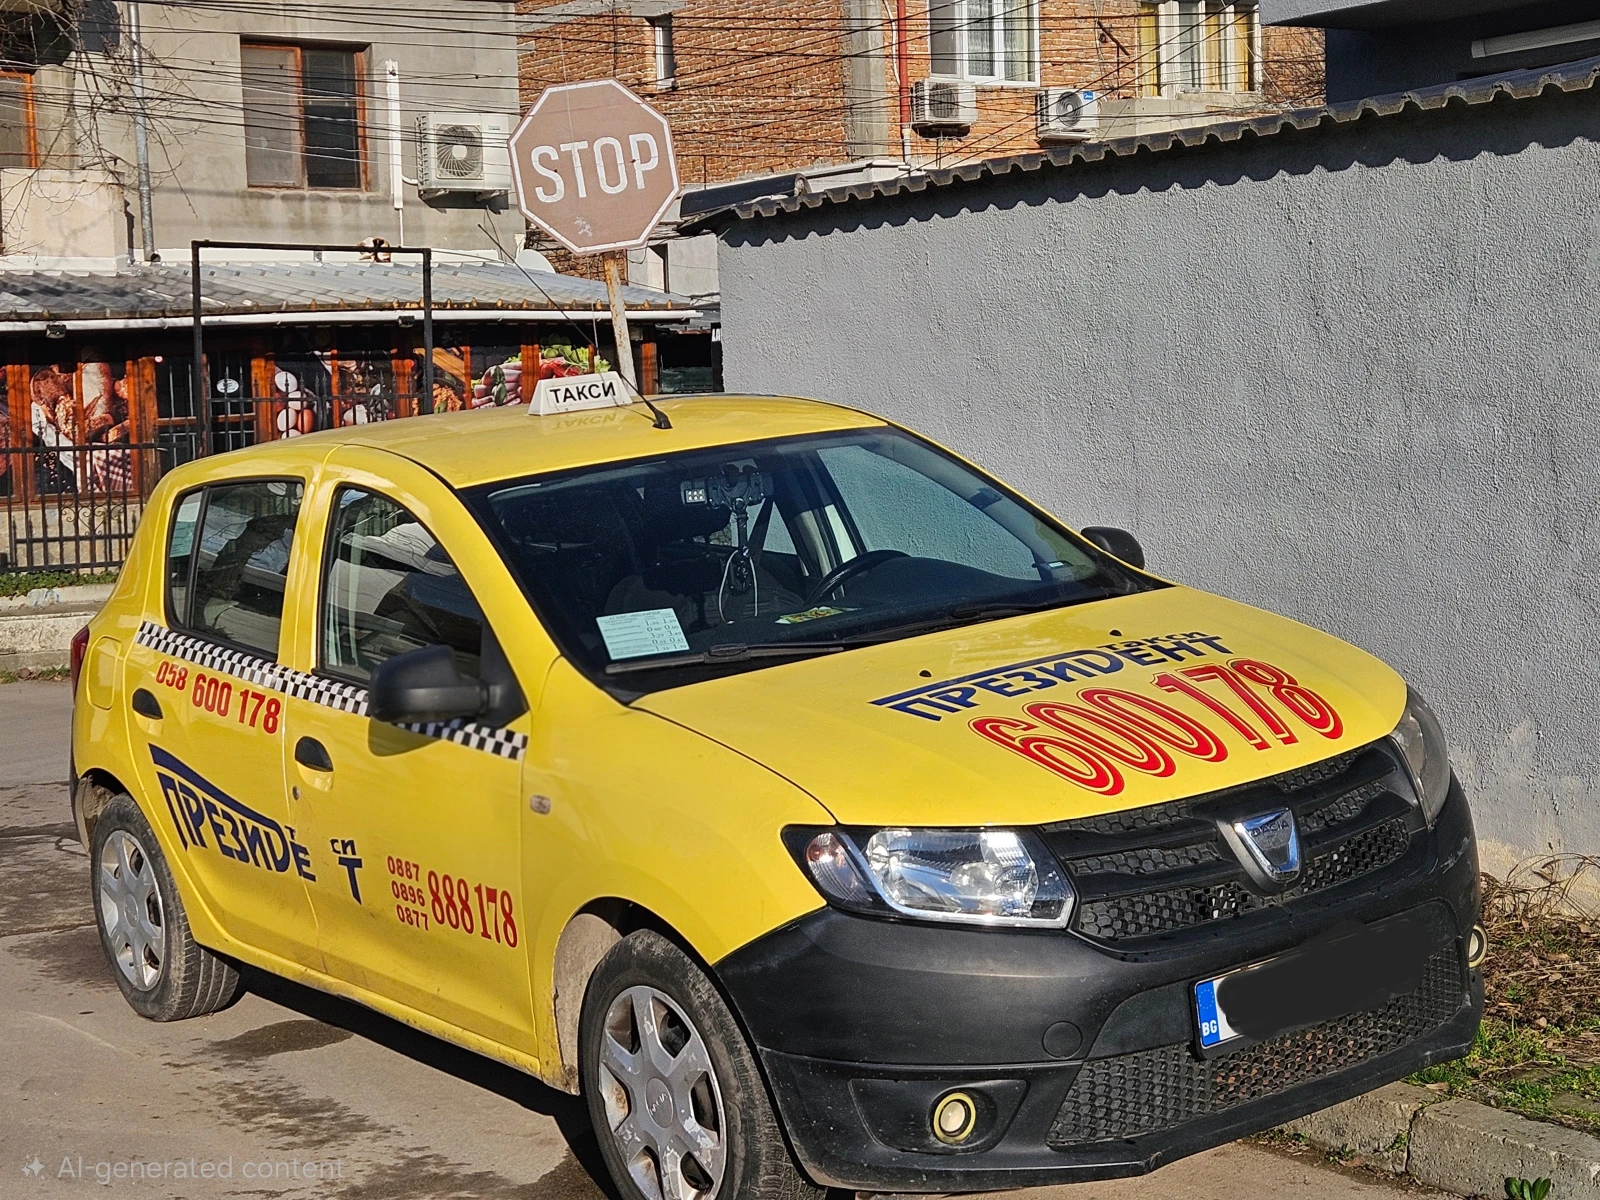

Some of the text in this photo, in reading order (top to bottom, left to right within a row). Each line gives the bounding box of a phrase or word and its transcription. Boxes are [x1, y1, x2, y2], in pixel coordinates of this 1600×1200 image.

[531, 133, 659, 203] STOP
[549, 381, 616, 404] ТАКСИ
[1096, 631, 1210, 651] такси
[156, 660, 281, 734] 058 600 178
[1251, 819, 1290, 837] DACIA
[387, 855, 420, 882] 0887
[391, 880, 426, 907] 0896
[396, 904, 429, 931] 0877
[1201, 1019, 1218, 1037] BG
